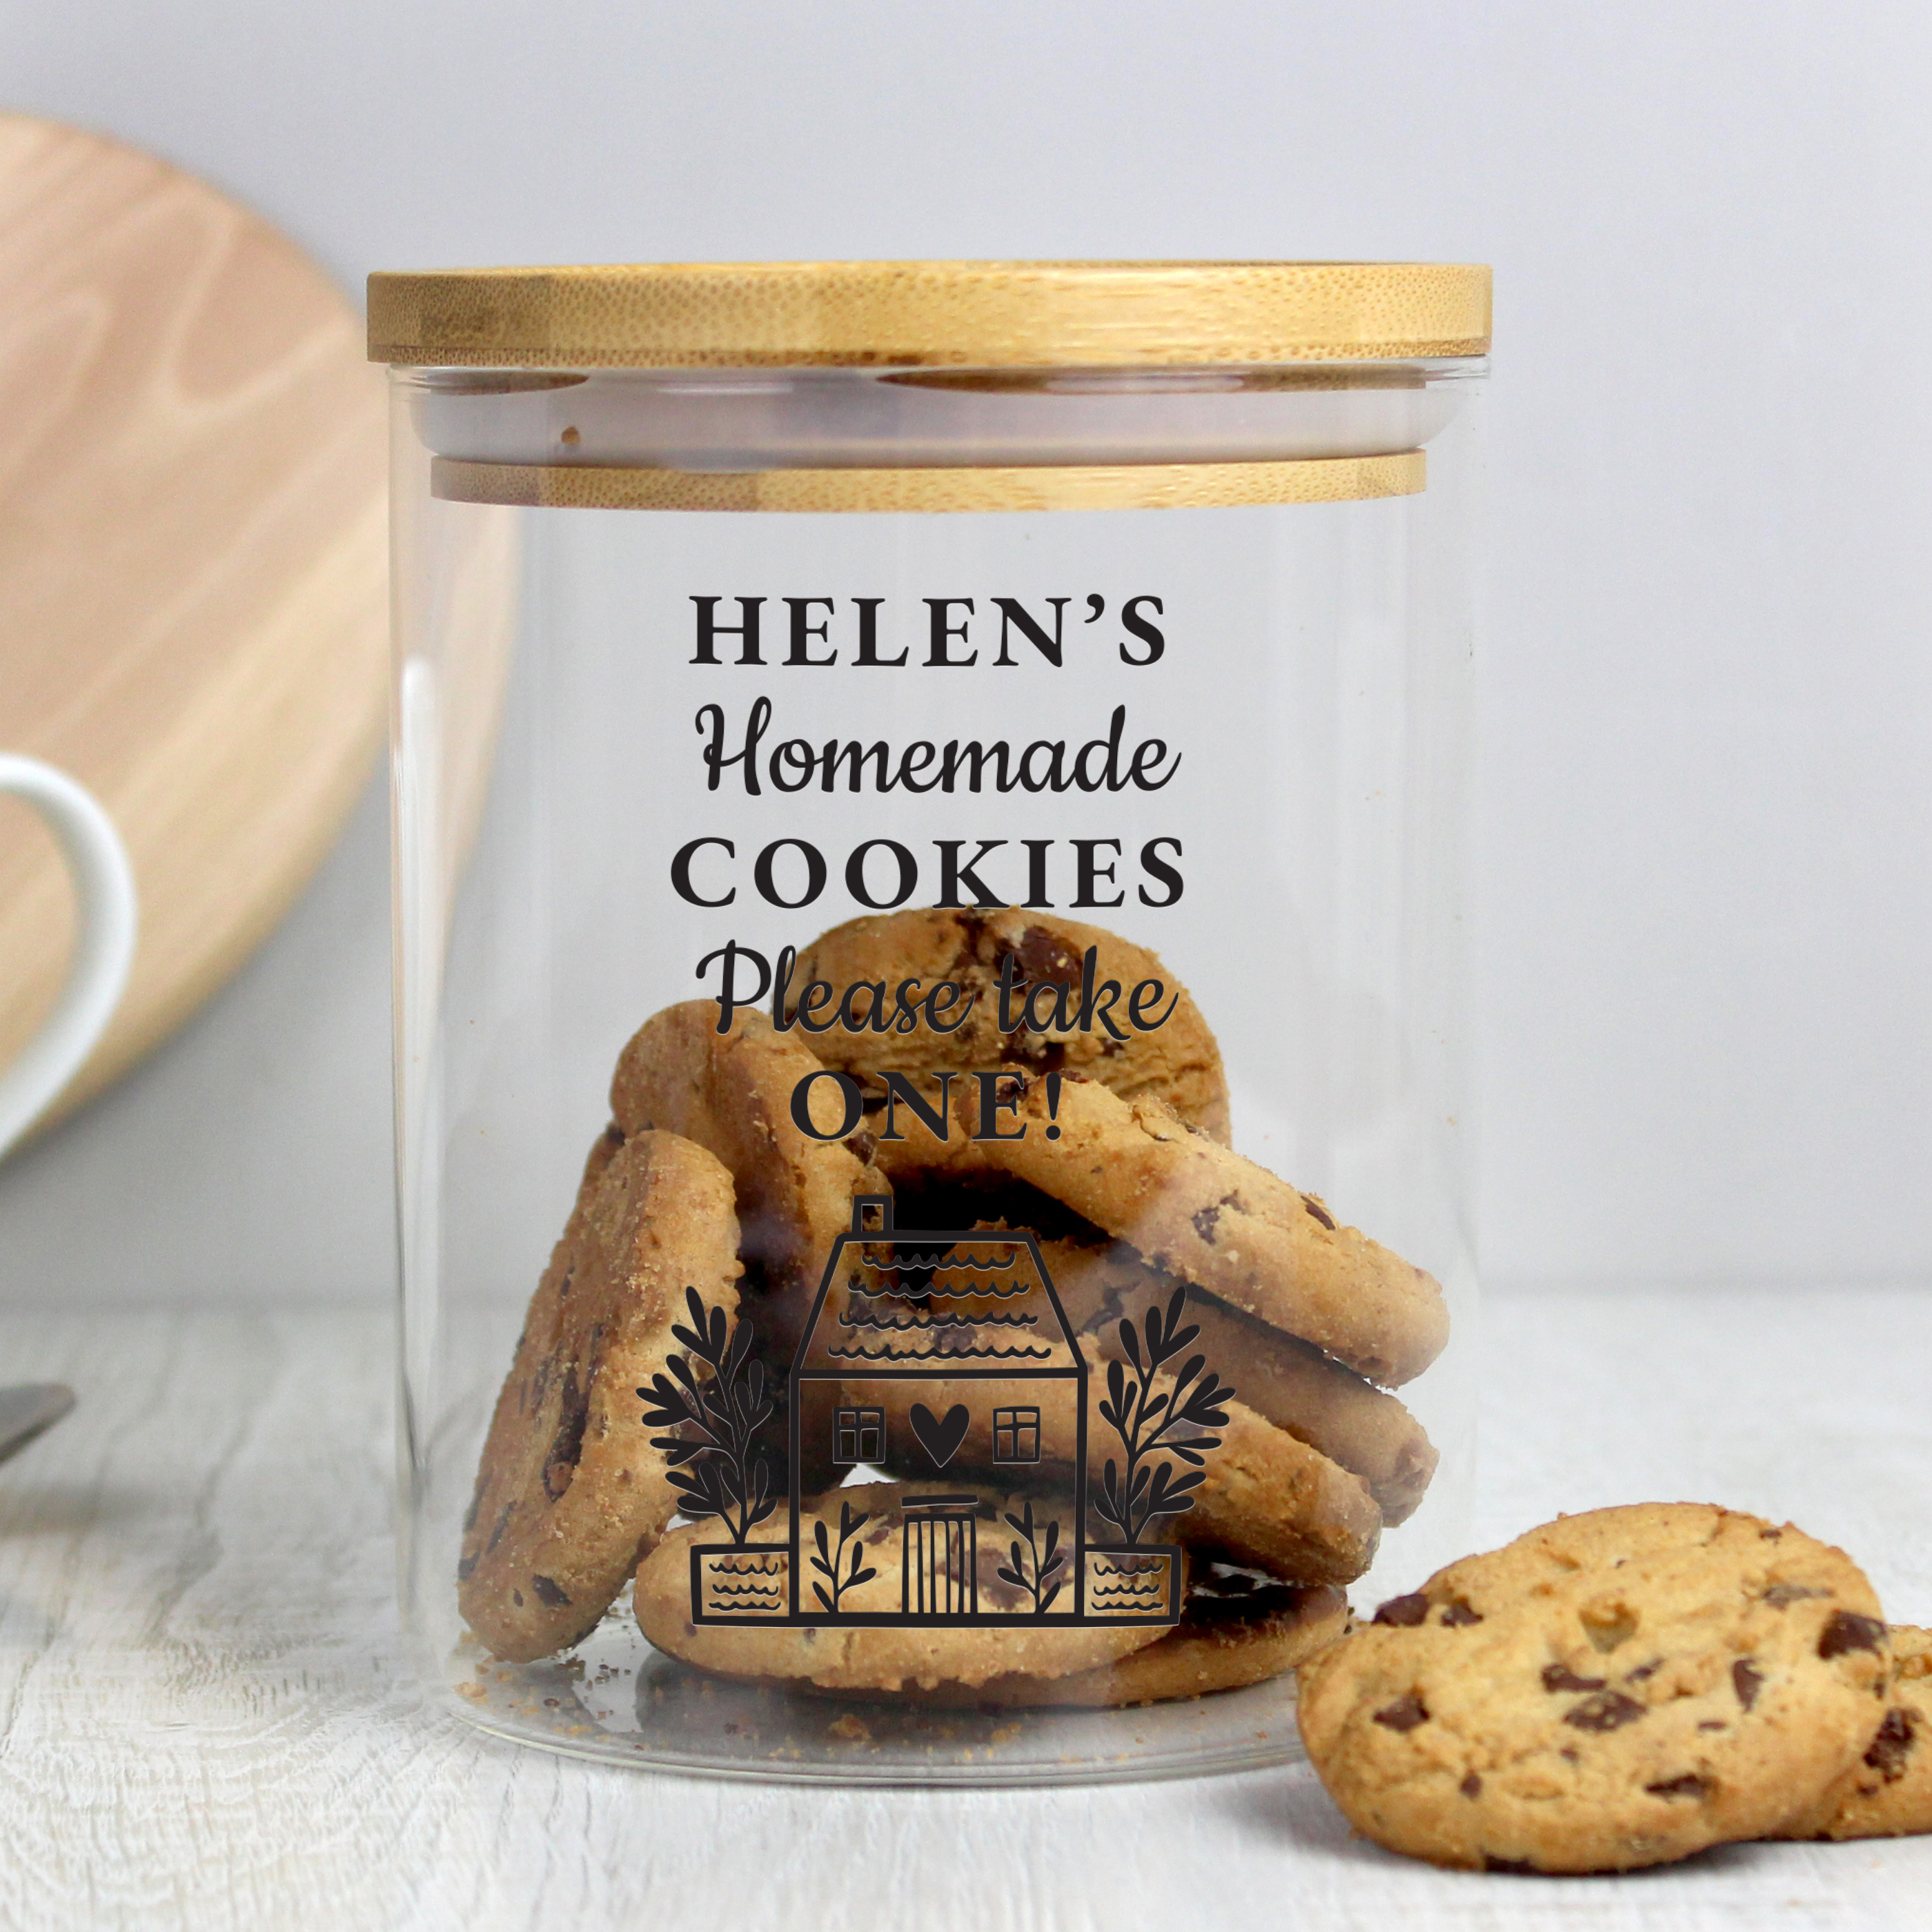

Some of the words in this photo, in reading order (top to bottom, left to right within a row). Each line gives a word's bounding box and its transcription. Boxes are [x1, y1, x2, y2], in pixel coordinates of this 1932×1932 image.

[688, 593, 1165, 668] HELEN’S
[694, 696, 1182, 796] Homemade
[670, 836, 1184, 909] COOKIES
[695, 938, 975, 1035] Please
[993, 945, 1179, 1041] take
[789, 1070, 1063, 1142] ONE!
